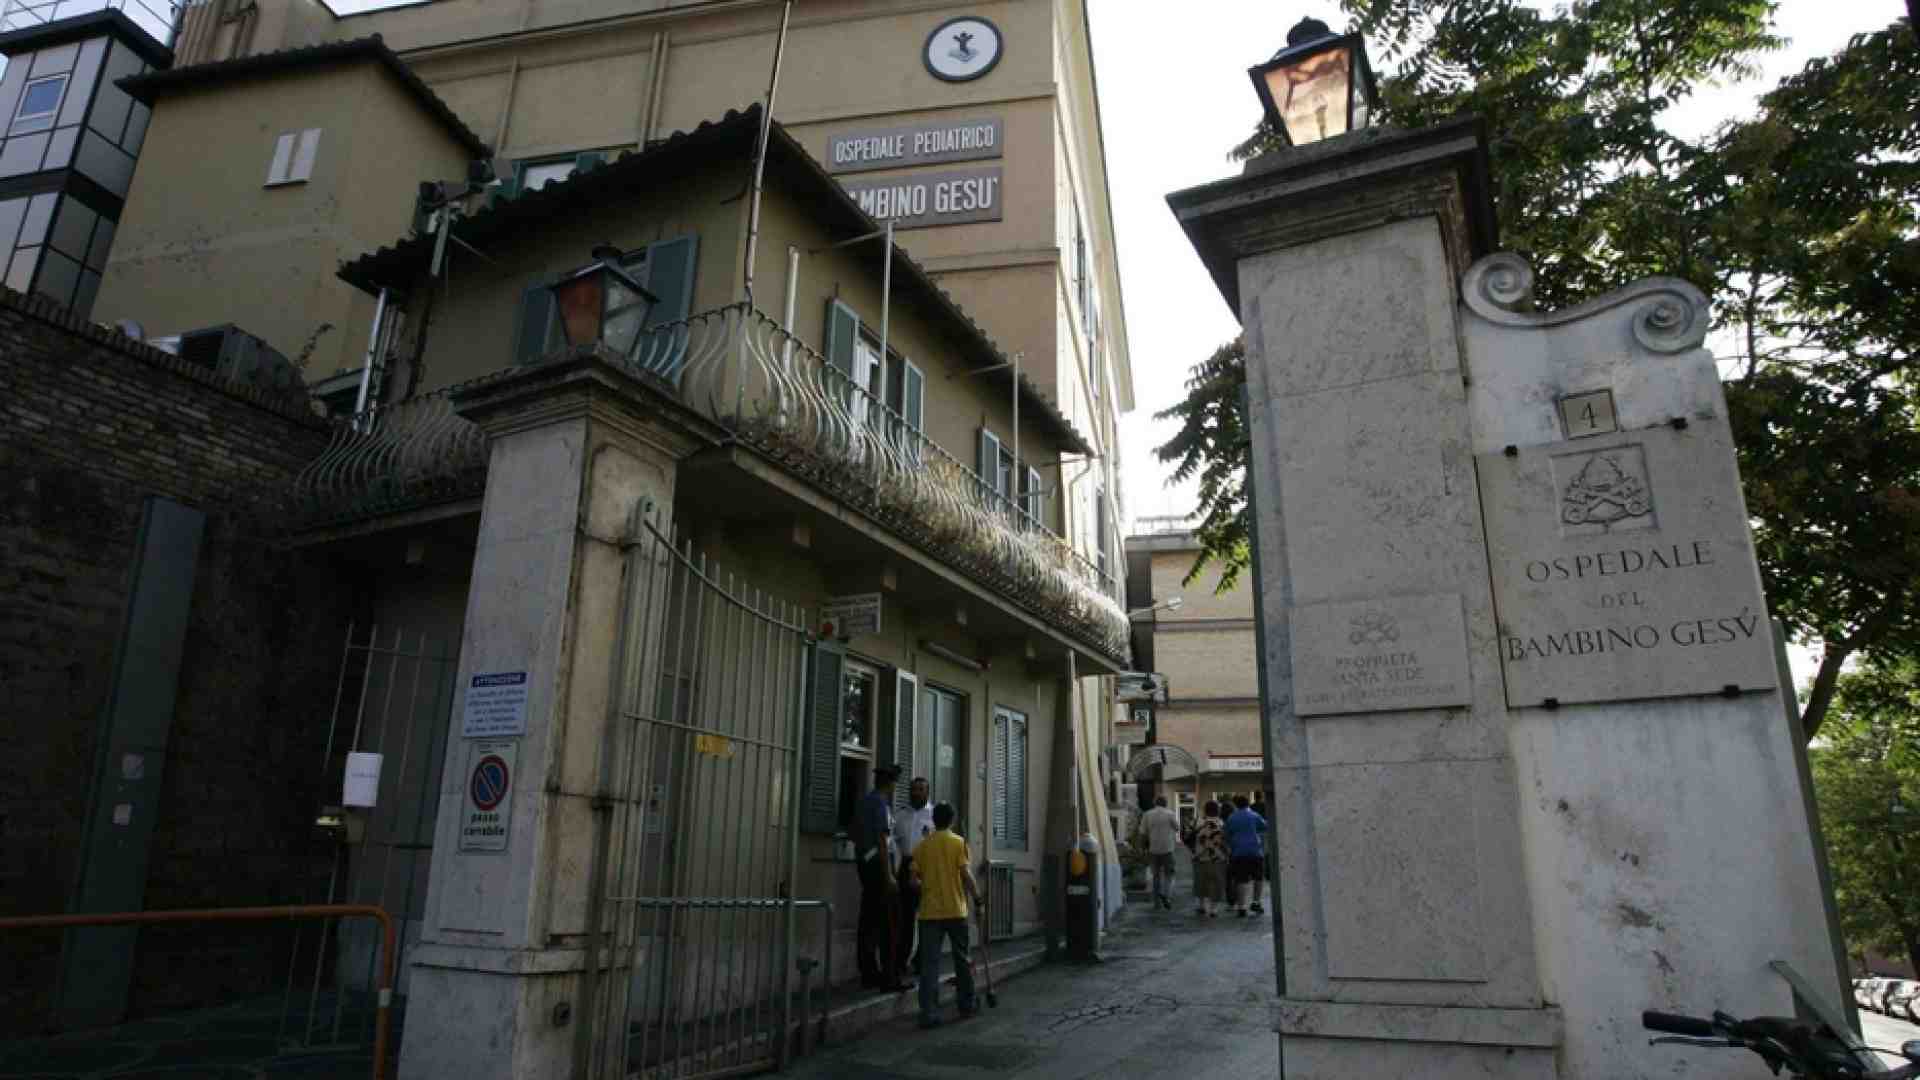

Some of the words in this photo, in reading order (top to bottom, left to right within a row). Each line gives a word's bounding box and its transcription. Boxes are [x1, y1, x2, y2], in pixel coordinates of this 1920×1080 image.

[835, 135, 904, 163] OSPEDALE
[914, 124, 994, 154] PEDIATRICO
[1582, 403, 1598, 428] 4
[1526, 540, 1715, 583] OSPEDALE
[1508, 624, 1659, 662] BAMBINO
